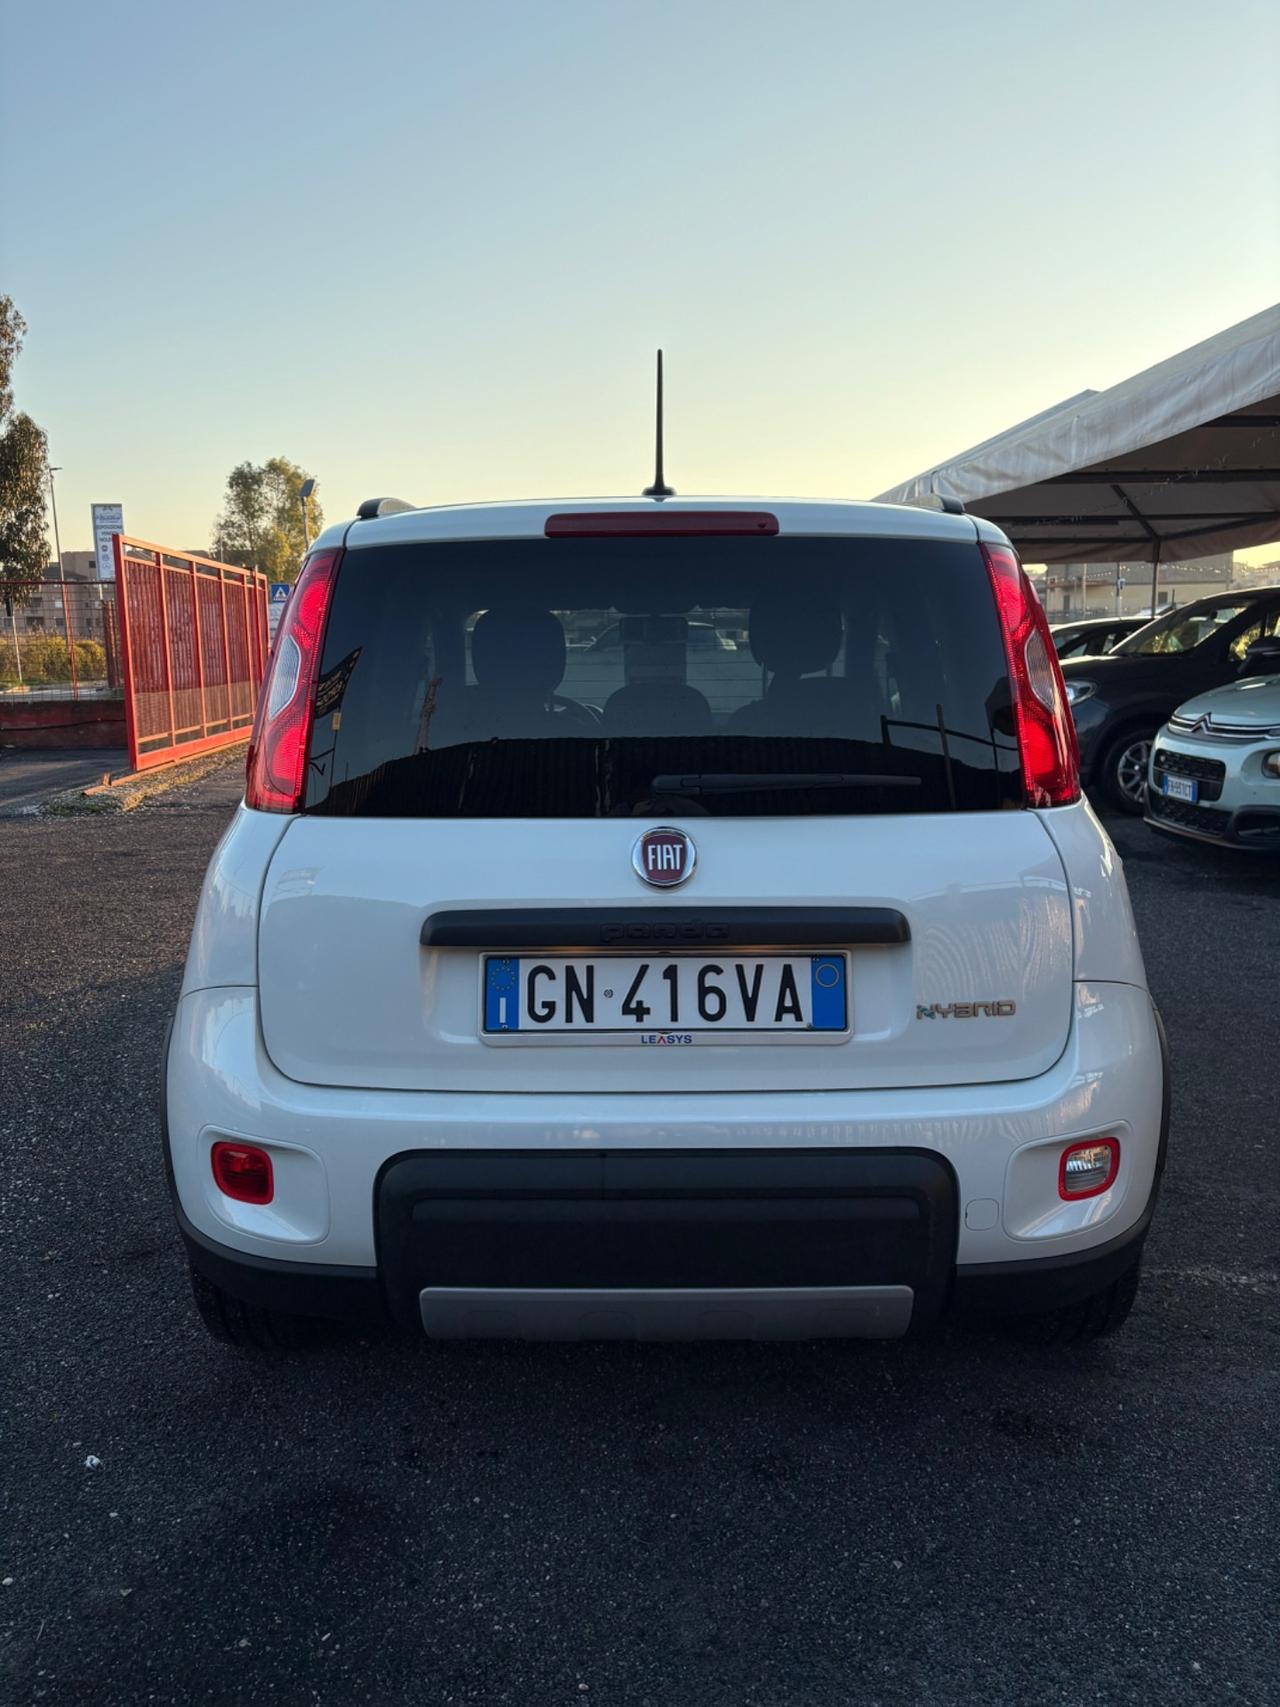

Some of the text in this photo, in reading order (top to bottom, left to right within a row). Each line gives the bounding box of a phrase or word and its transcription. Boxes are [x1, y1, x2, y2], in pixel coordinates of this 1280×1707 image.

[647, 844, 683, 870] FIAT
[916, 1000, 1017, 1020] HYBRID
[641, 1034, 693, 1044] LEASYS
